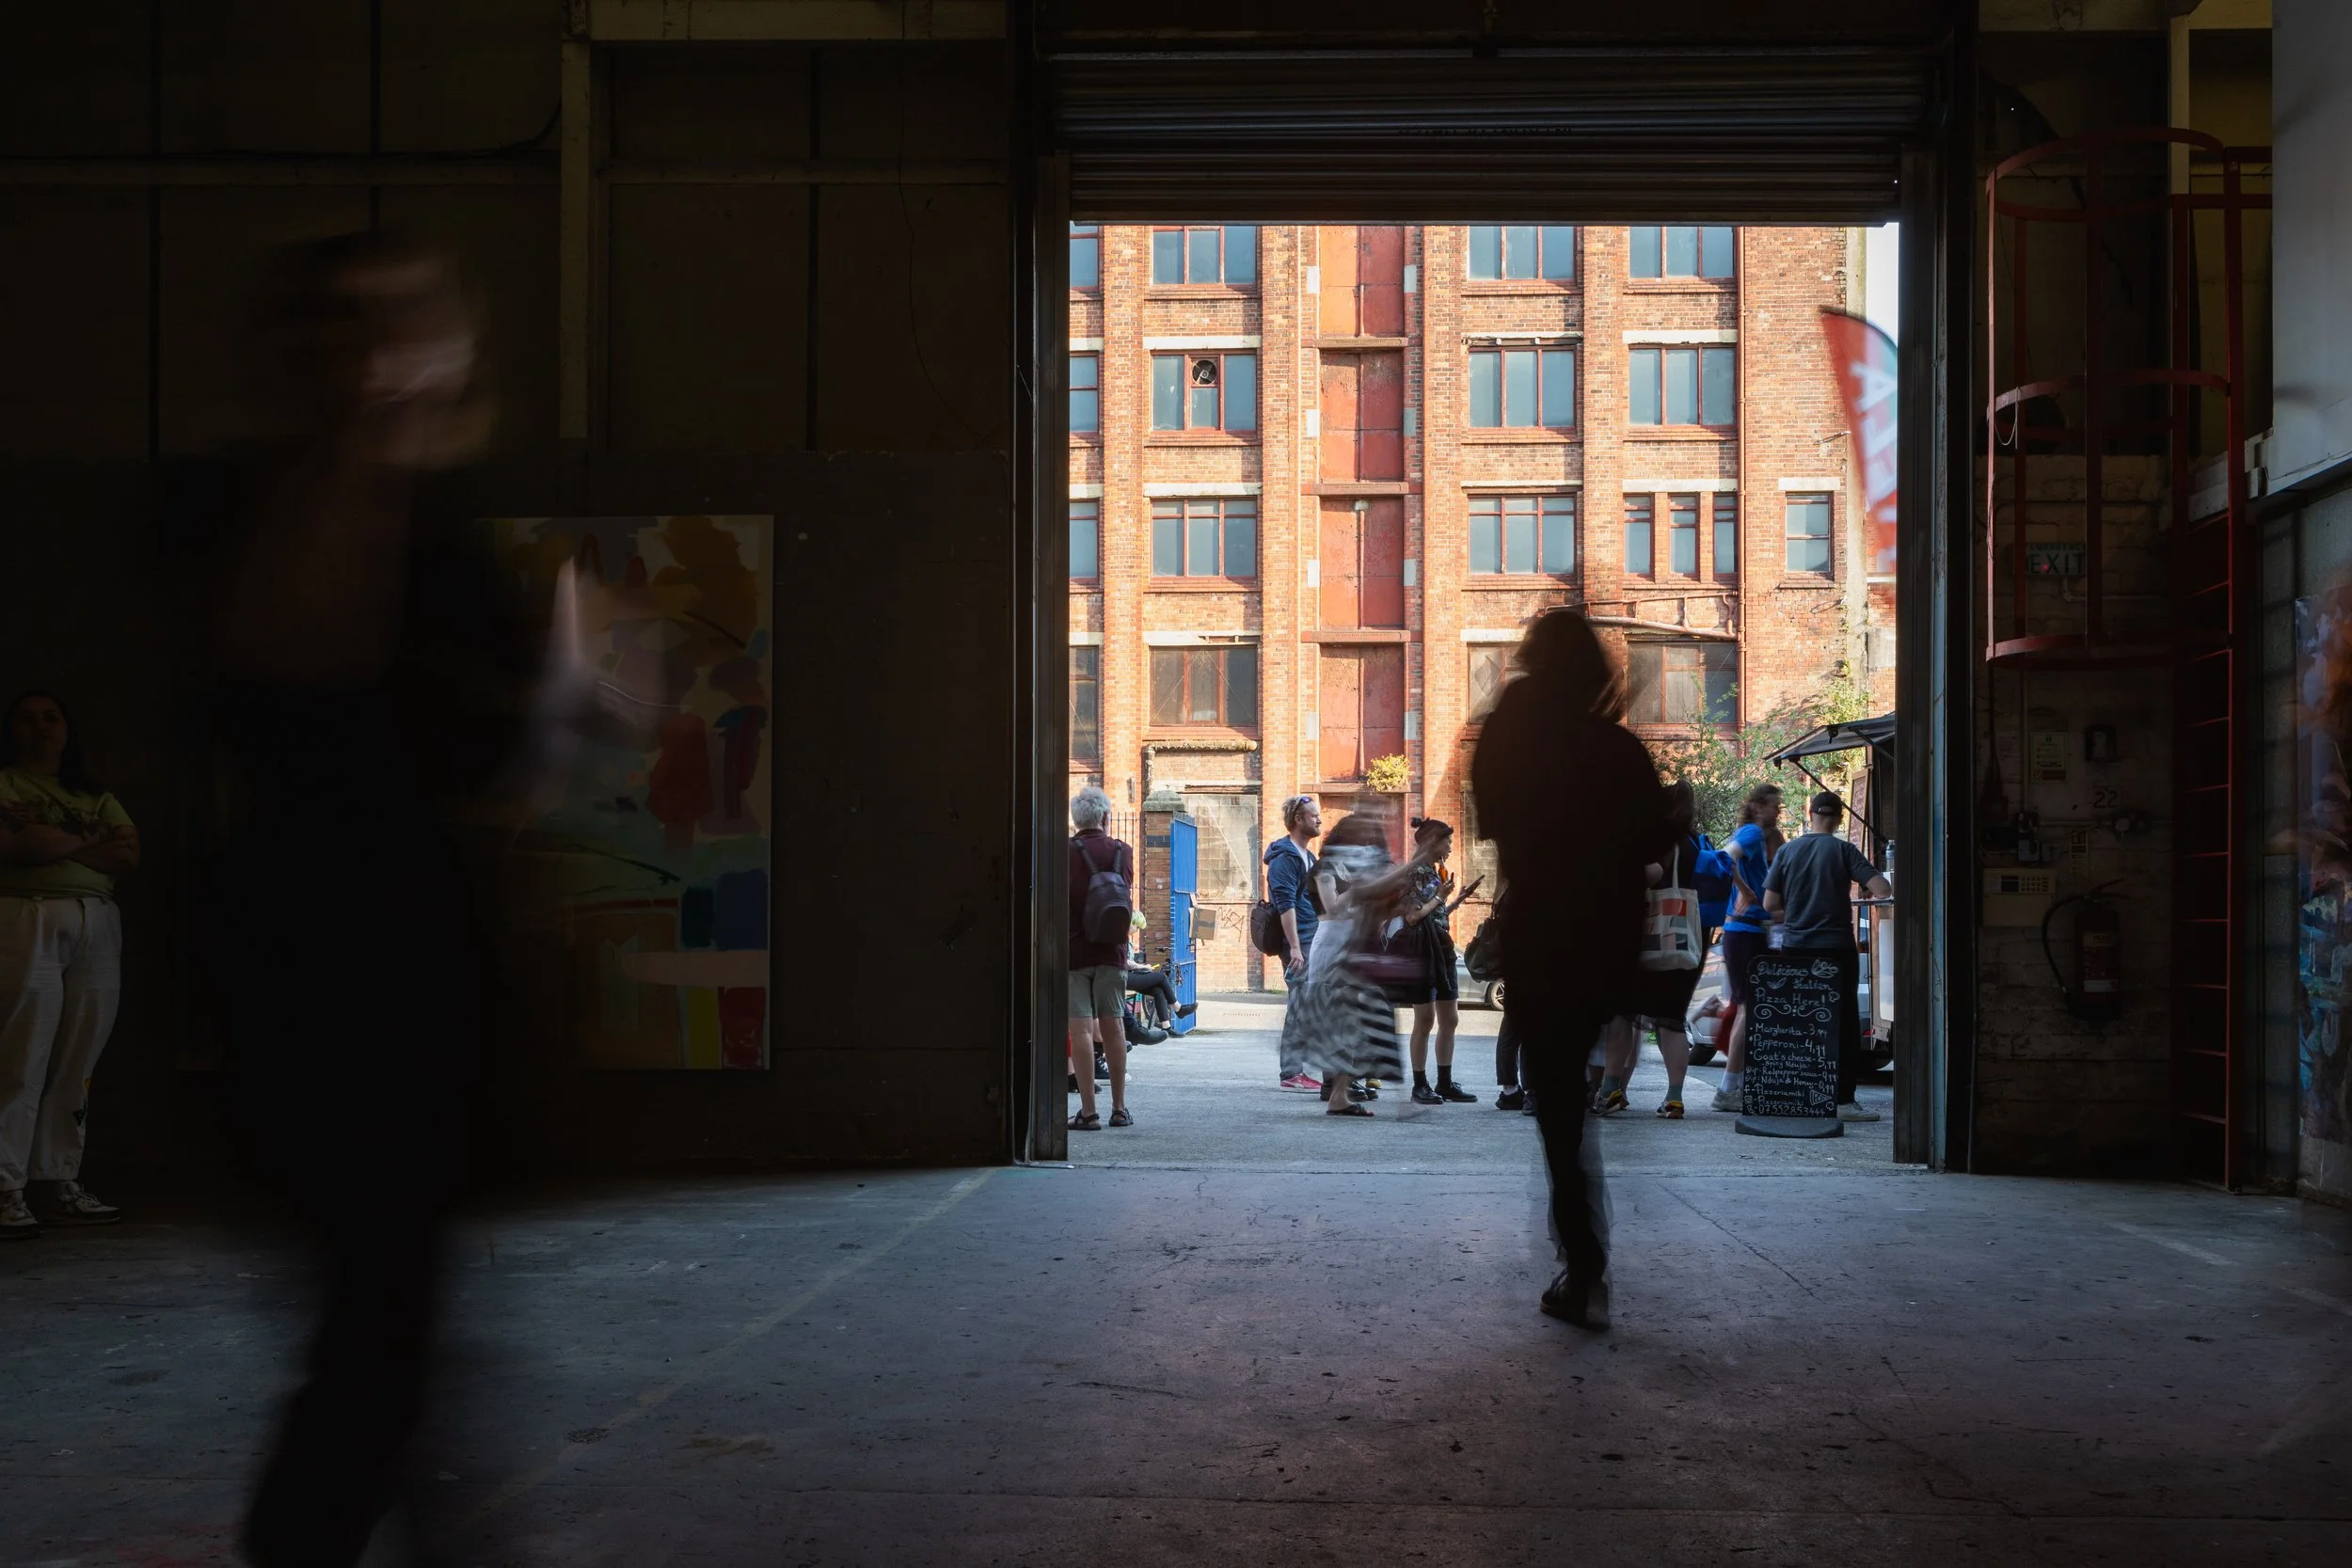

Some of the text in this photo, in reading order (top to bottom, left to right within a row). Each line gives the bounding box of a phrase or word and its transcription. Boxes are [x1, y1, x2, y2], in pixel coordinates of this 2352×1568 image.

[2031, 554, 2086, 574] EXIT
[2094, 792, 2118, 809] 22
[1755, 987, 1788, 1003] Pizza
